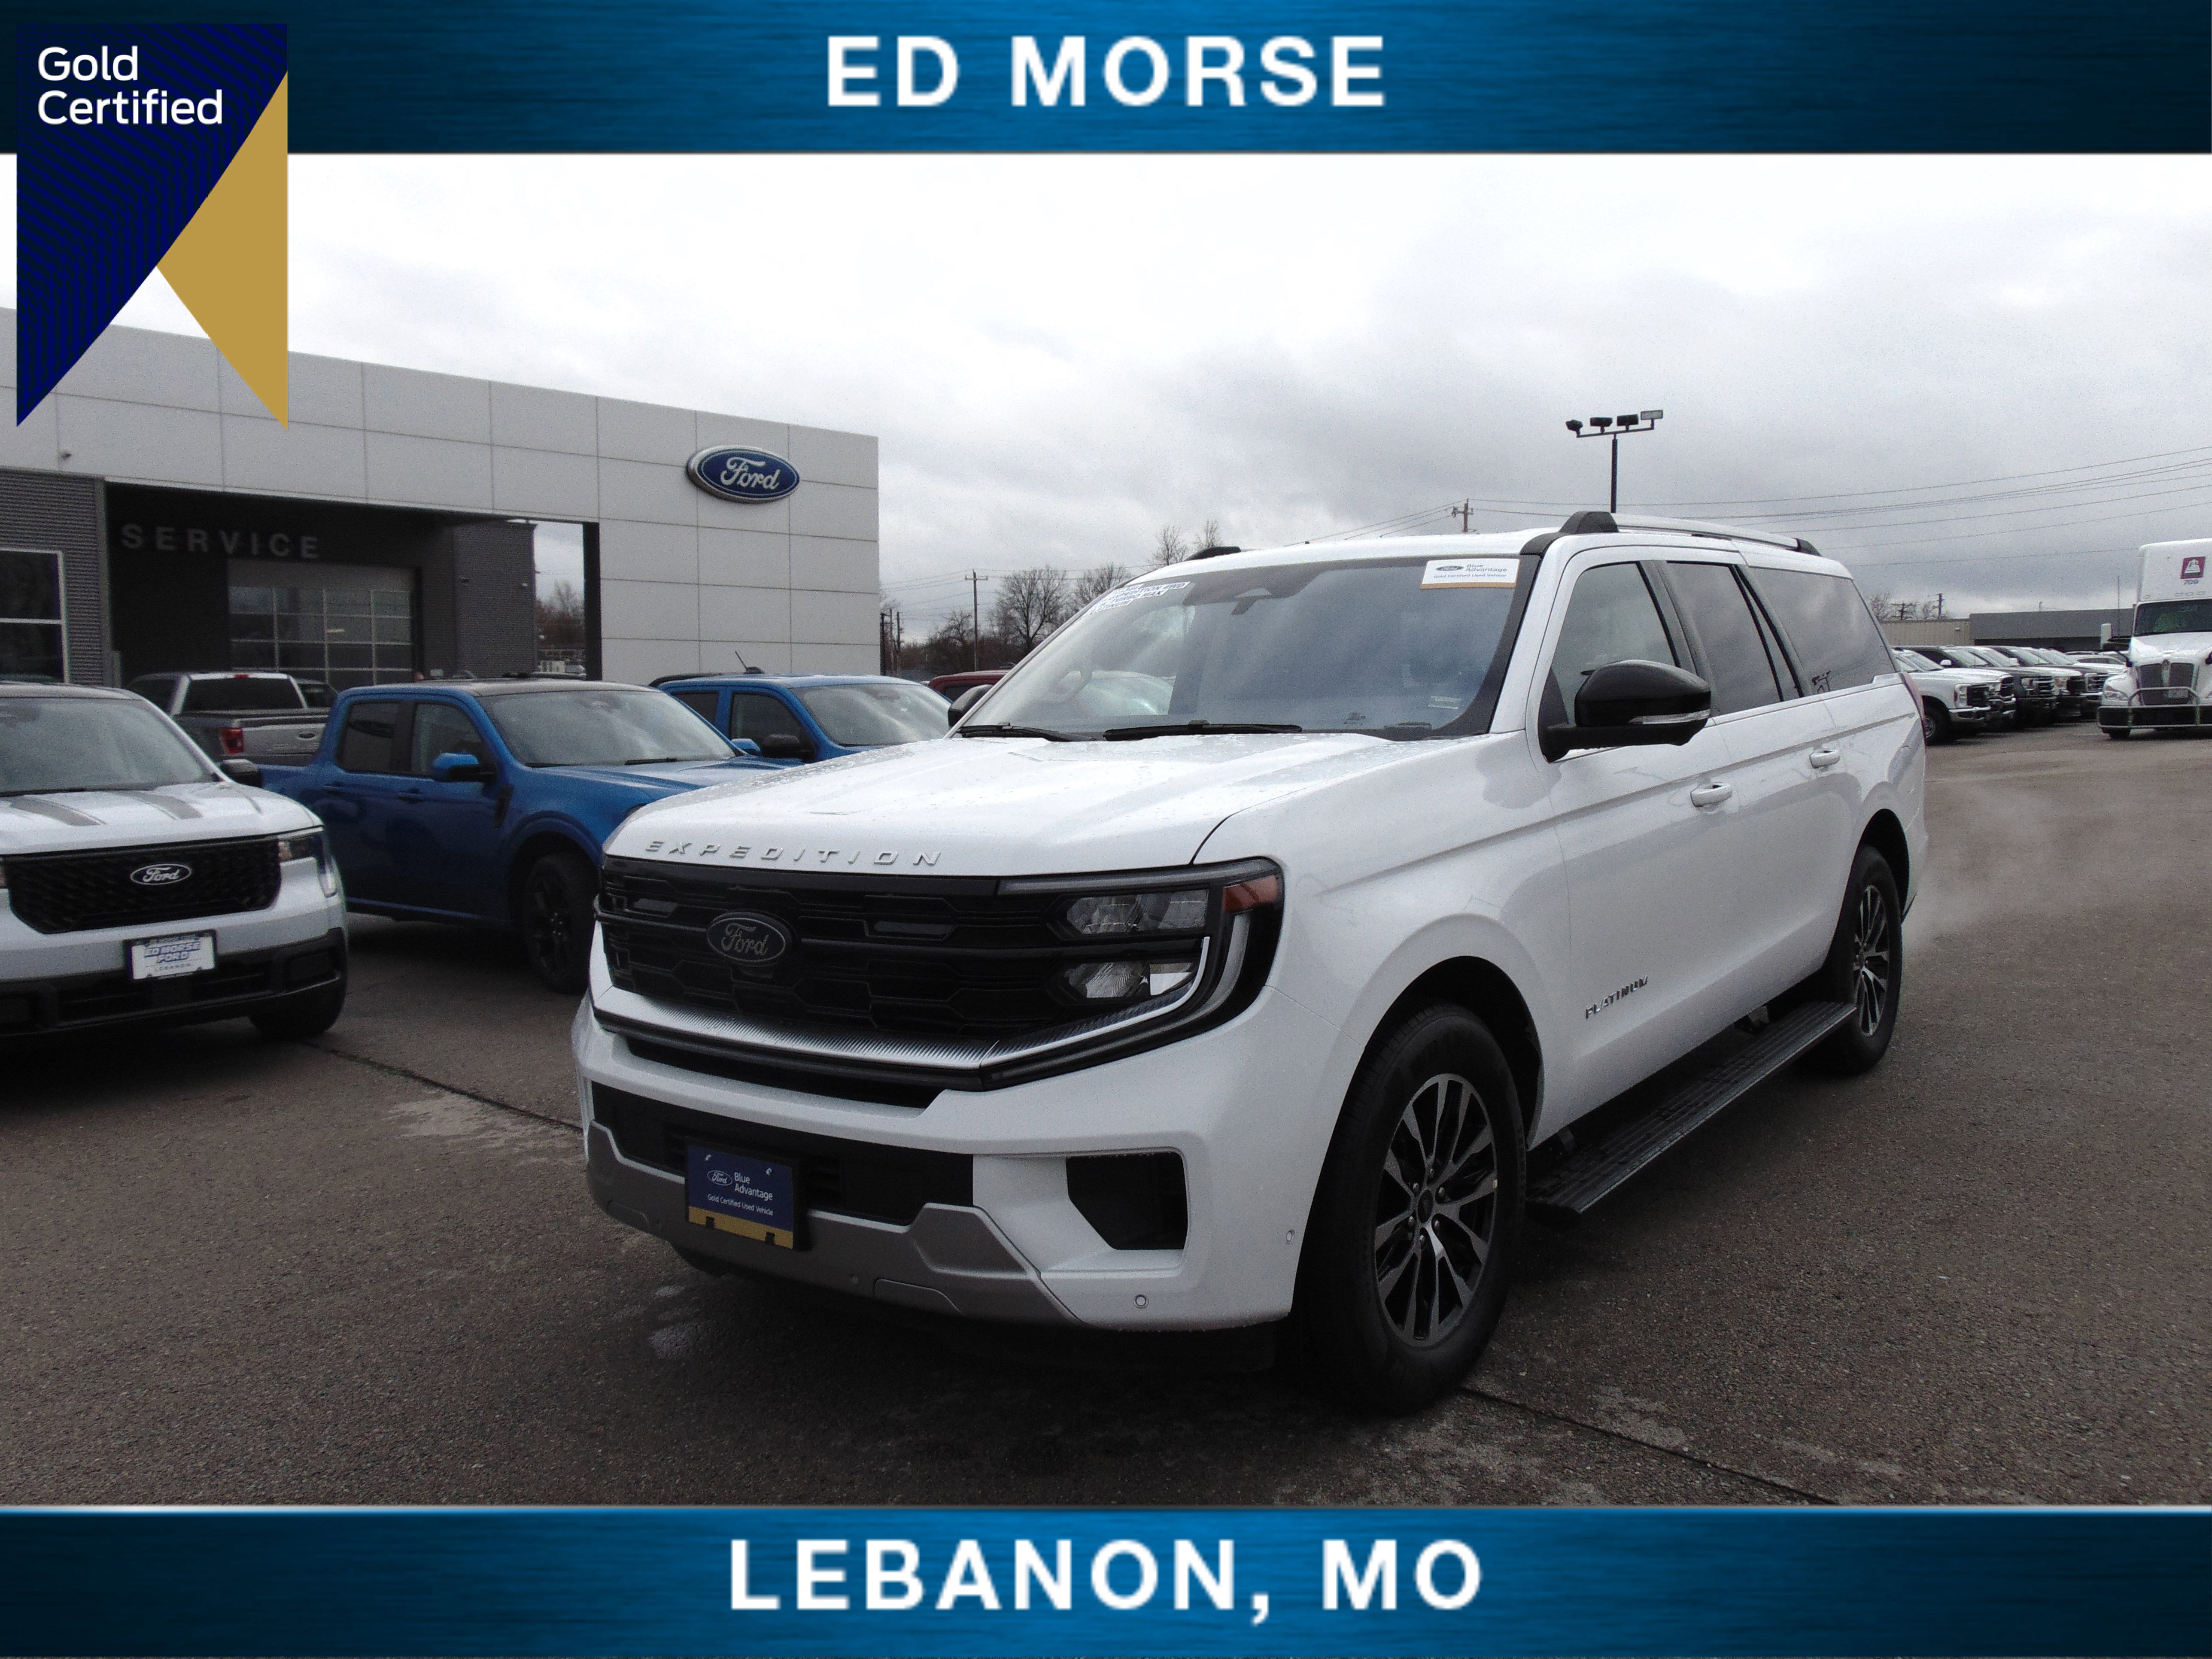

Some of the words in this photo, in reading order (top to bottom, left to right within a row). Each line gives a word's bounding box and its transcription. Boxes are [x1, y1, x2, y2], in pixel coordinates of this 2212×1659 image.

[720, 457, 780, 490] Ford
[121, 524, 319, 559] SERVICE
[645, 840, 942, 866] EXPEDITION
[143, 866, 179, 882] Ford
[145, 948, 159, 956] ED
[161, 943, 200, 953] MORSE
[721, 923, 769, 956] Ford
[157, 952, 189, 962] FORD
[1585, 975, 1649, 1020] PLATINUM
[712, 1172, 728, 1184] Ford
[734, 1172, 750, 1184] Blue
[734, 1183, 774, 1201] Advantage
[707, 1194, 719, 1203] Gold
[720, 1196, 741, 1208] Certified
[741, 1202, 755, 1211] Used
[756, 1205, 774, 1216] Vehicle
